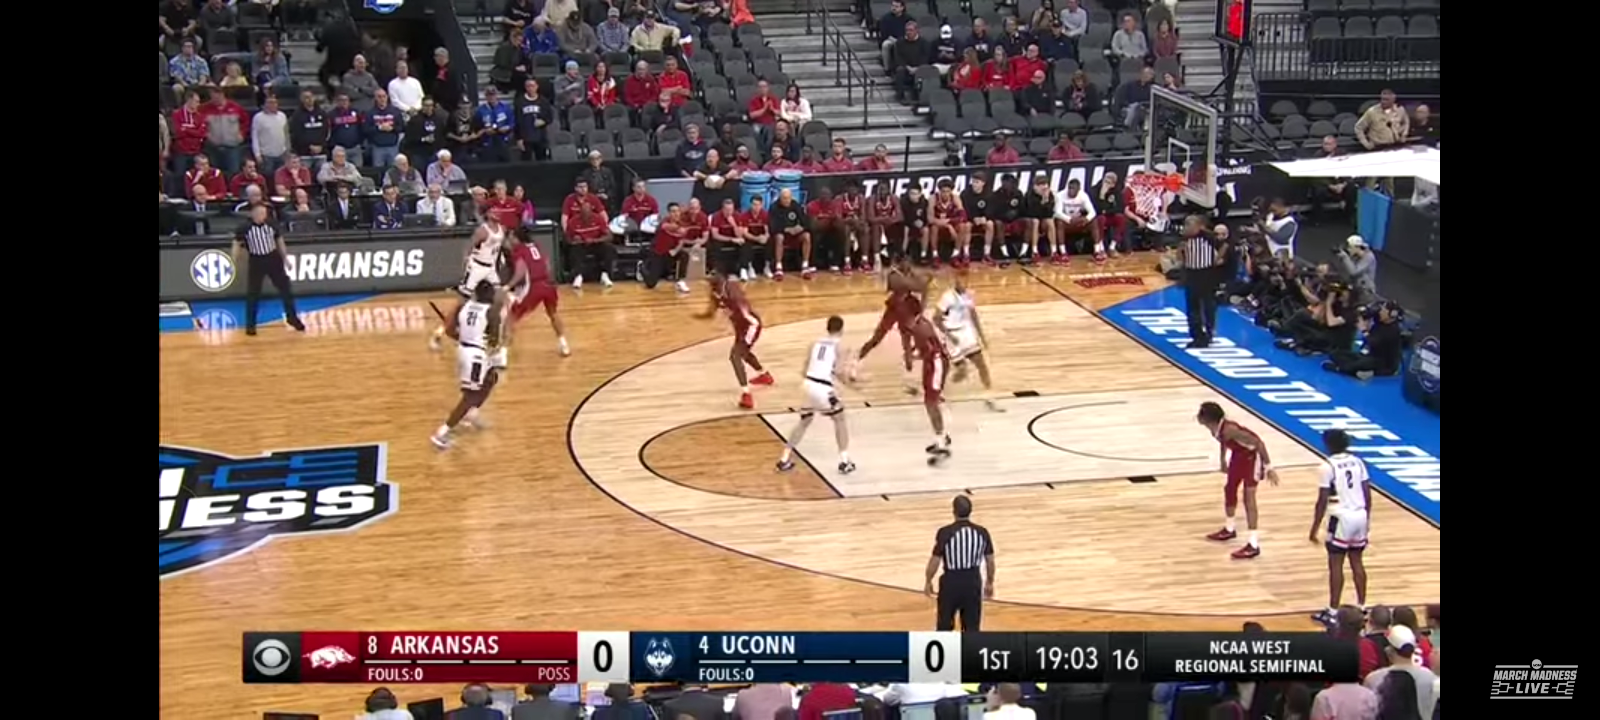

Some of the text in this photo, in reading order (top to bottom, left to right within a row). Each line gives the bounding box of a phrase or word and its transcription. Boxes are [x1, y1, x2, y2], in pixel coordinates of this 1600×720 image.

[285, 249, 424, 281] ARKANSAS
[529, 246, 541, 261] 0
[194, 253, 232, 288] SEC
[1121, 307, 1187, 335] THE
[1243, 381, 1332, 403] TO
[1285, 406, 1401, 442] THE
[1345, 470, 1353, 489] 2
[1346, 446, 1440, 501] FINA
[159, 484, 374, 530] ESS
